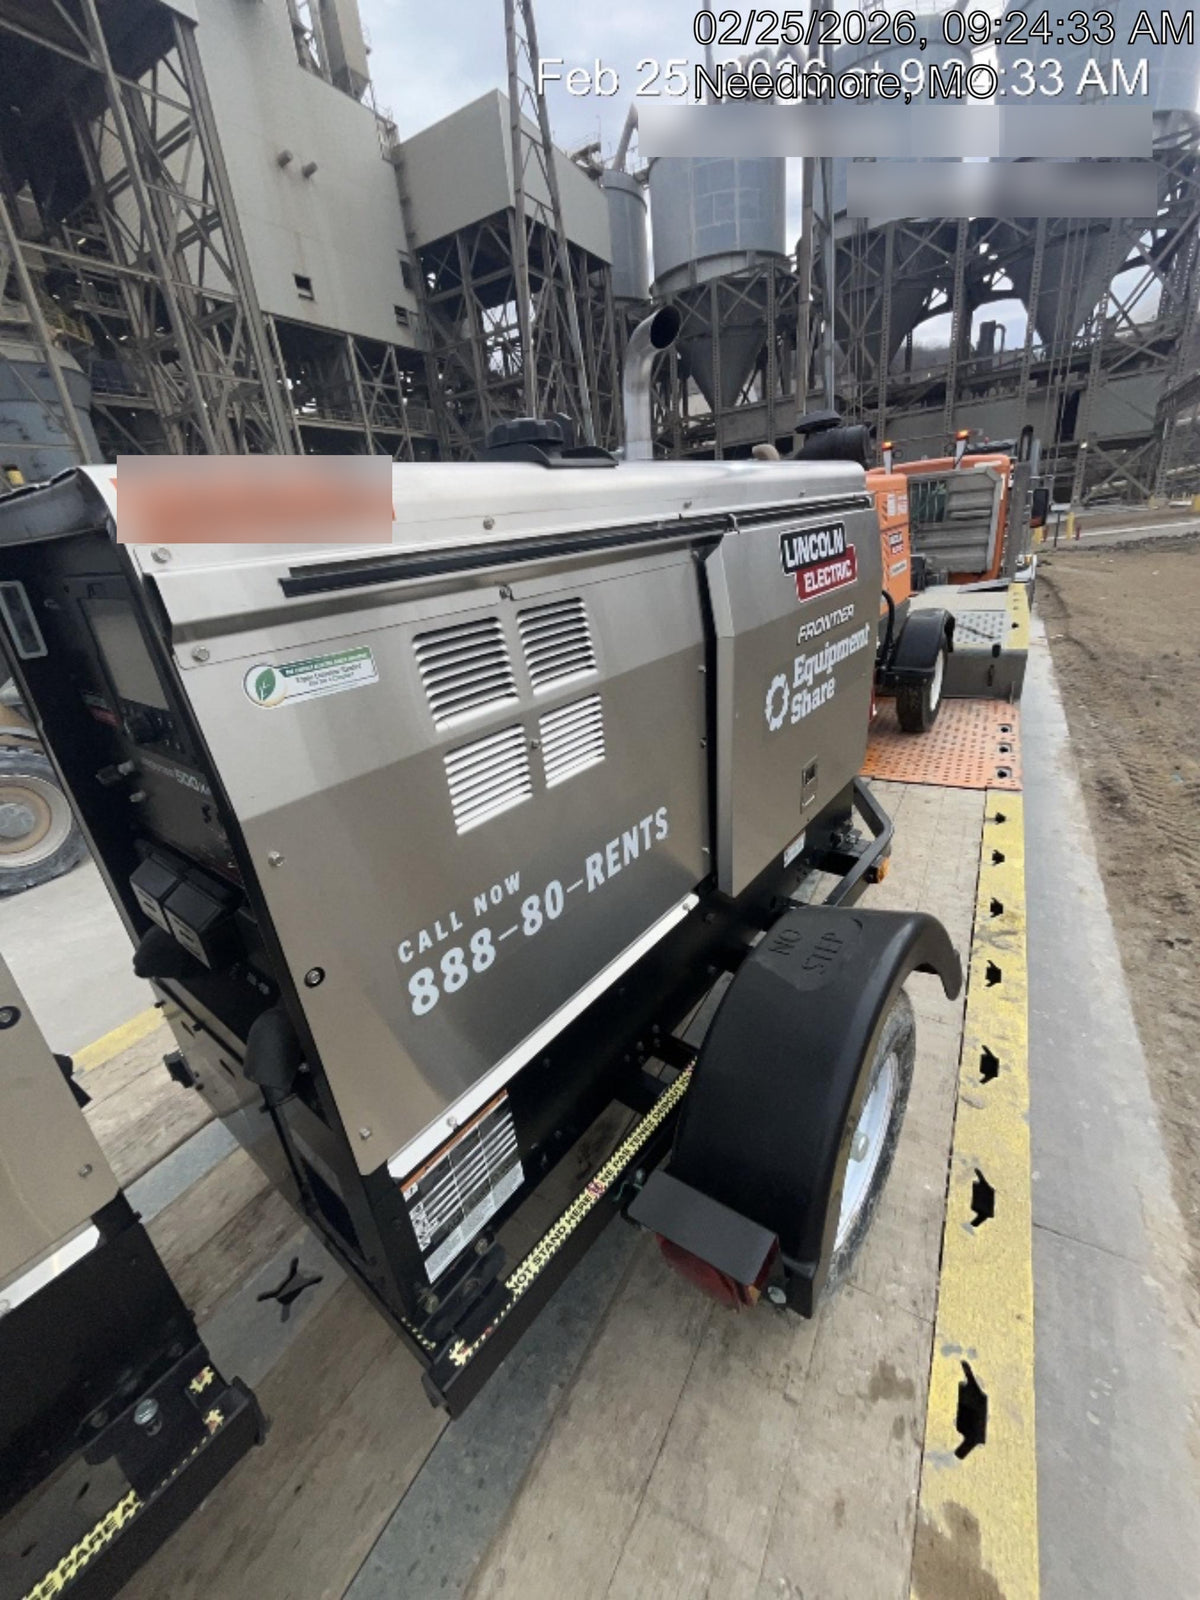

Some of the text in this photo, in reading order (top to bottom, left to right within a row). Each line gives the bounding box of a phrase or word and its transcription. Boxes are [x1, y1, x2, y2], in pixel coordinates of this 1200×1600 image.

[783, 527, 845, 569] LINCOLN
[803, 559, 853, 594] ELECTRIC
[797, 604, 855, 645] FRONTIER
[792, 622, 871, 688] Equipment
[790, 677, 836, 725] Share
[398, 871, 521, 963] CALL NOW
[408, 806, 669, 1016] 888-80-RENTS
[767, 929, 803, 956] NO
[801, 932, 844, 976] STEP
[510, 1195, 593, 1291] NOT STAND HERE
[59, 1516, 119, 1579] PARE
